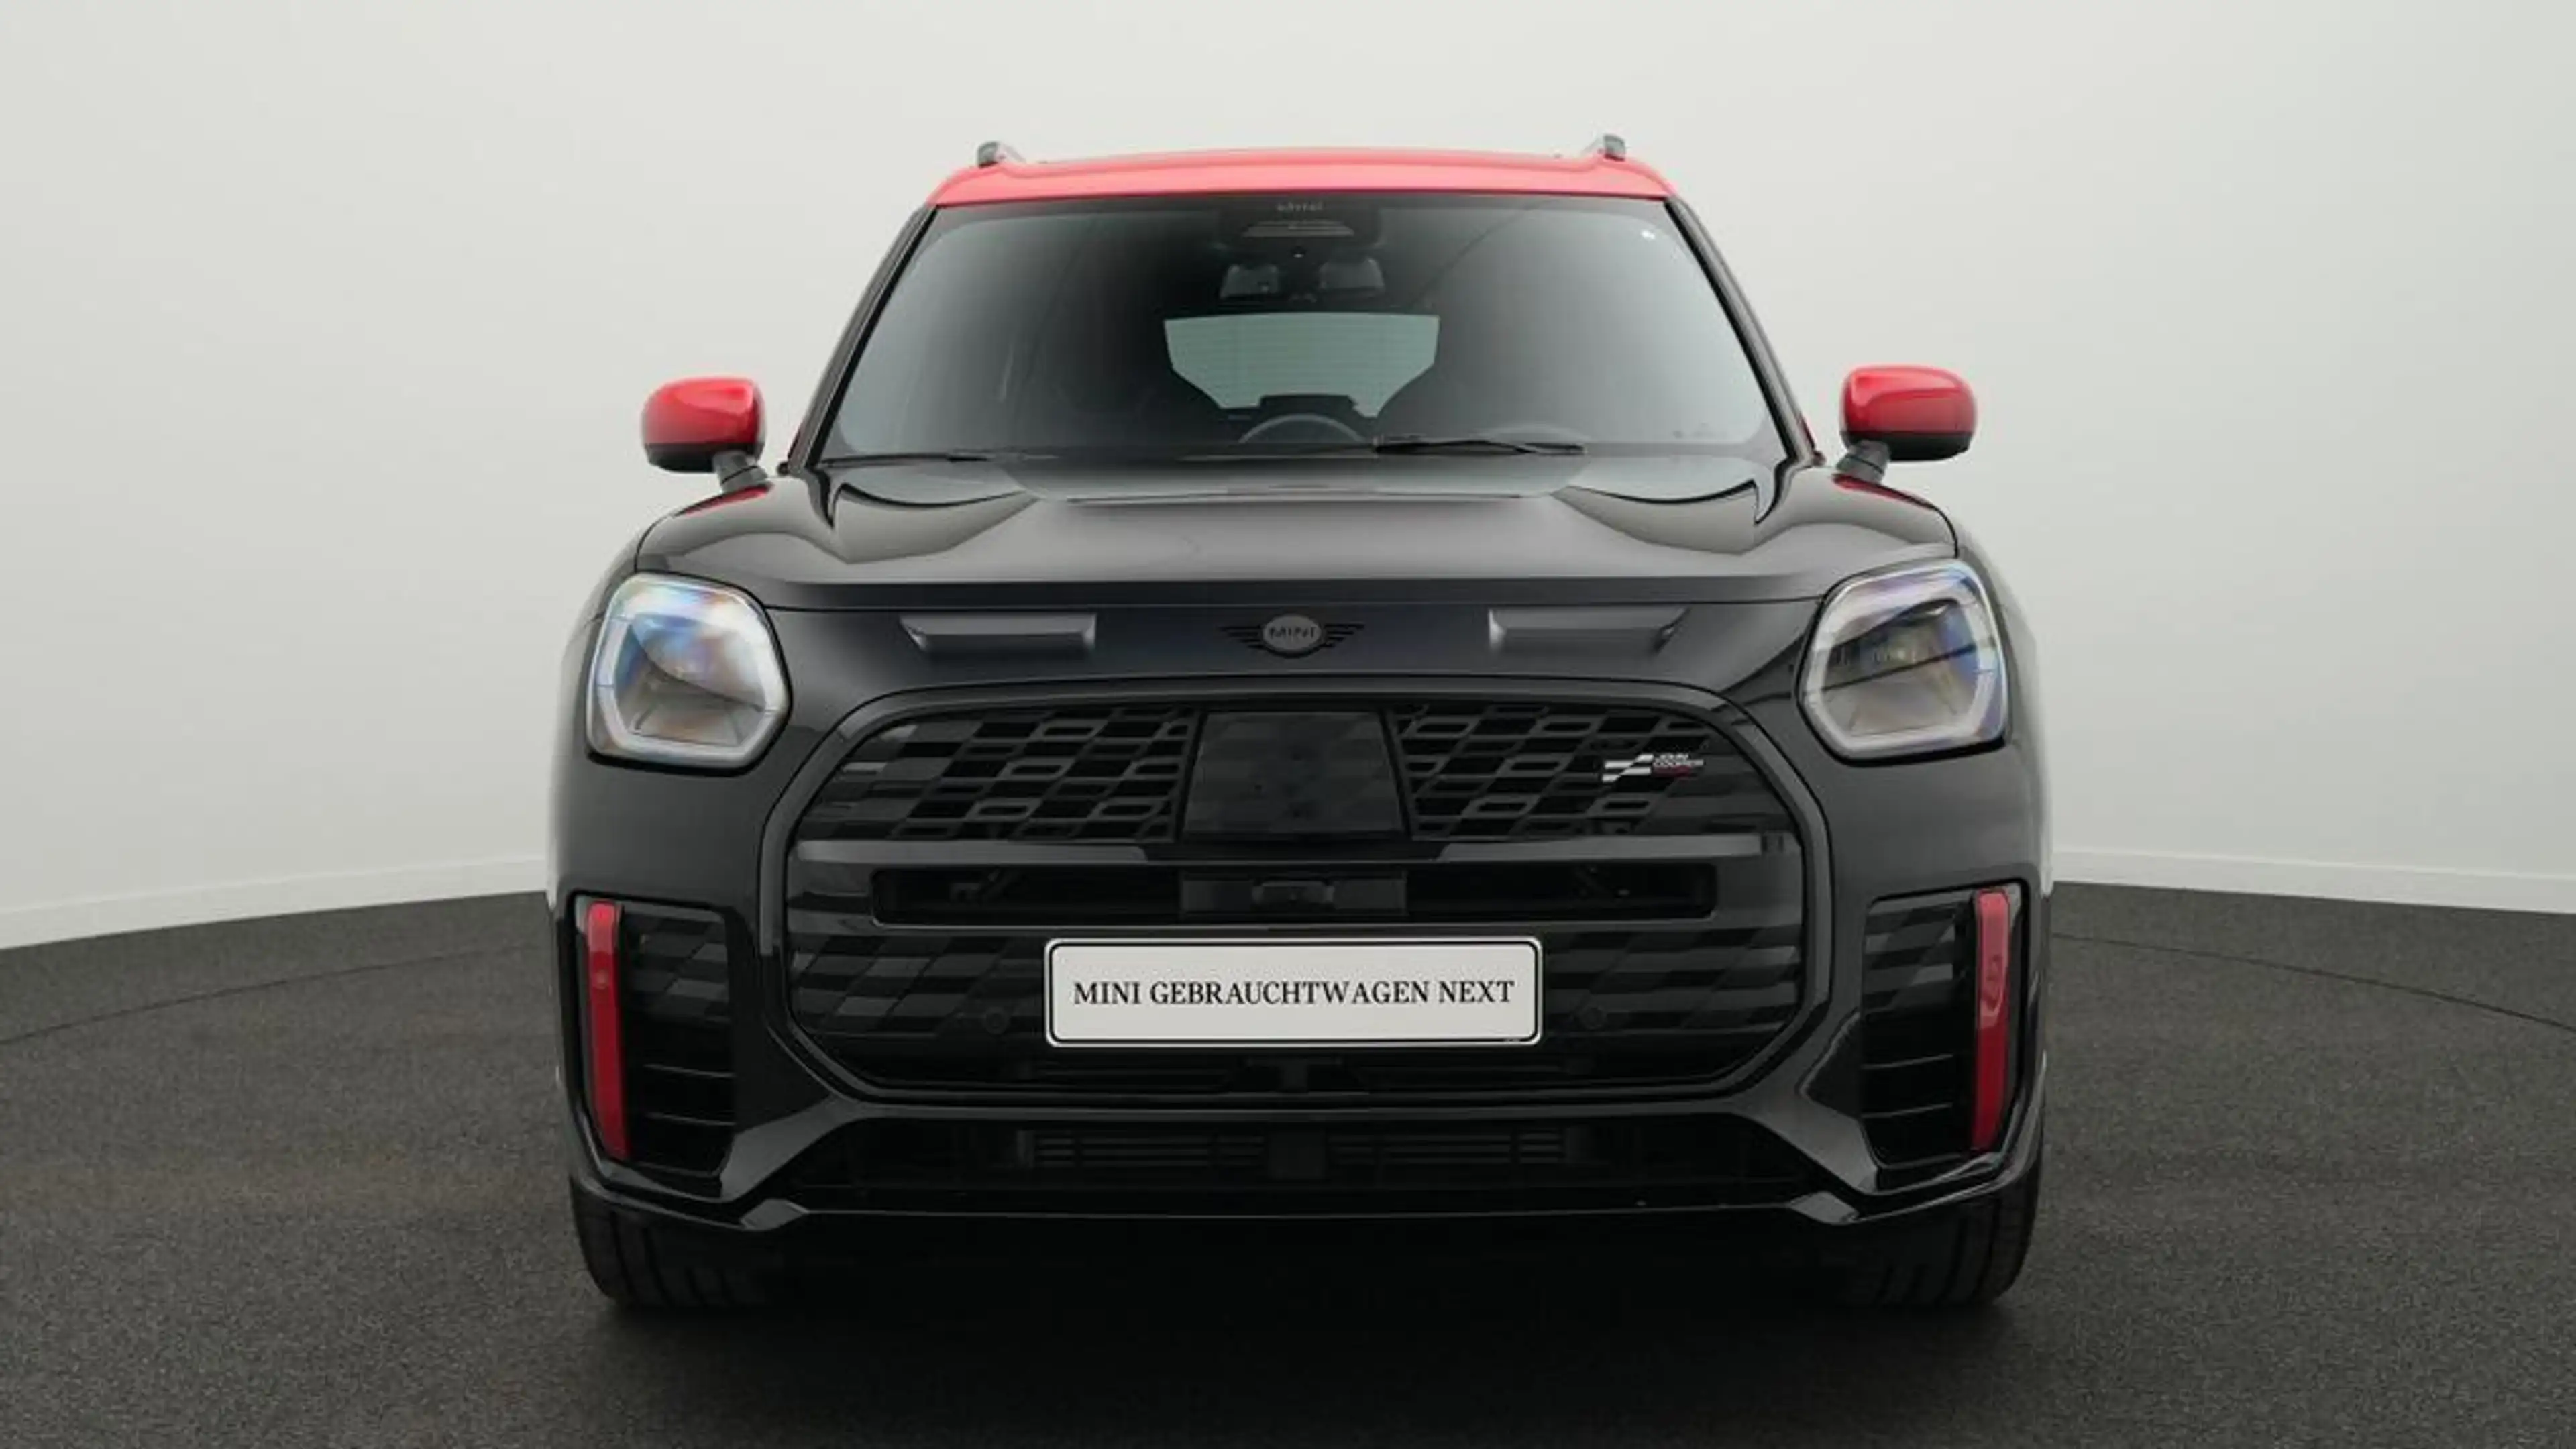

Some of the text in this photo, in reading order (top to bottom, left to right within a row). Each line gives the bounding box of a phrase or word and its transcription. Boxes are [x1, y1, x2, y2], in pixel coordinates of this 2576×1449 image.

[1074, 980, 1515, 1004] MINI GEBRAUCHTWAGEN NEXT
